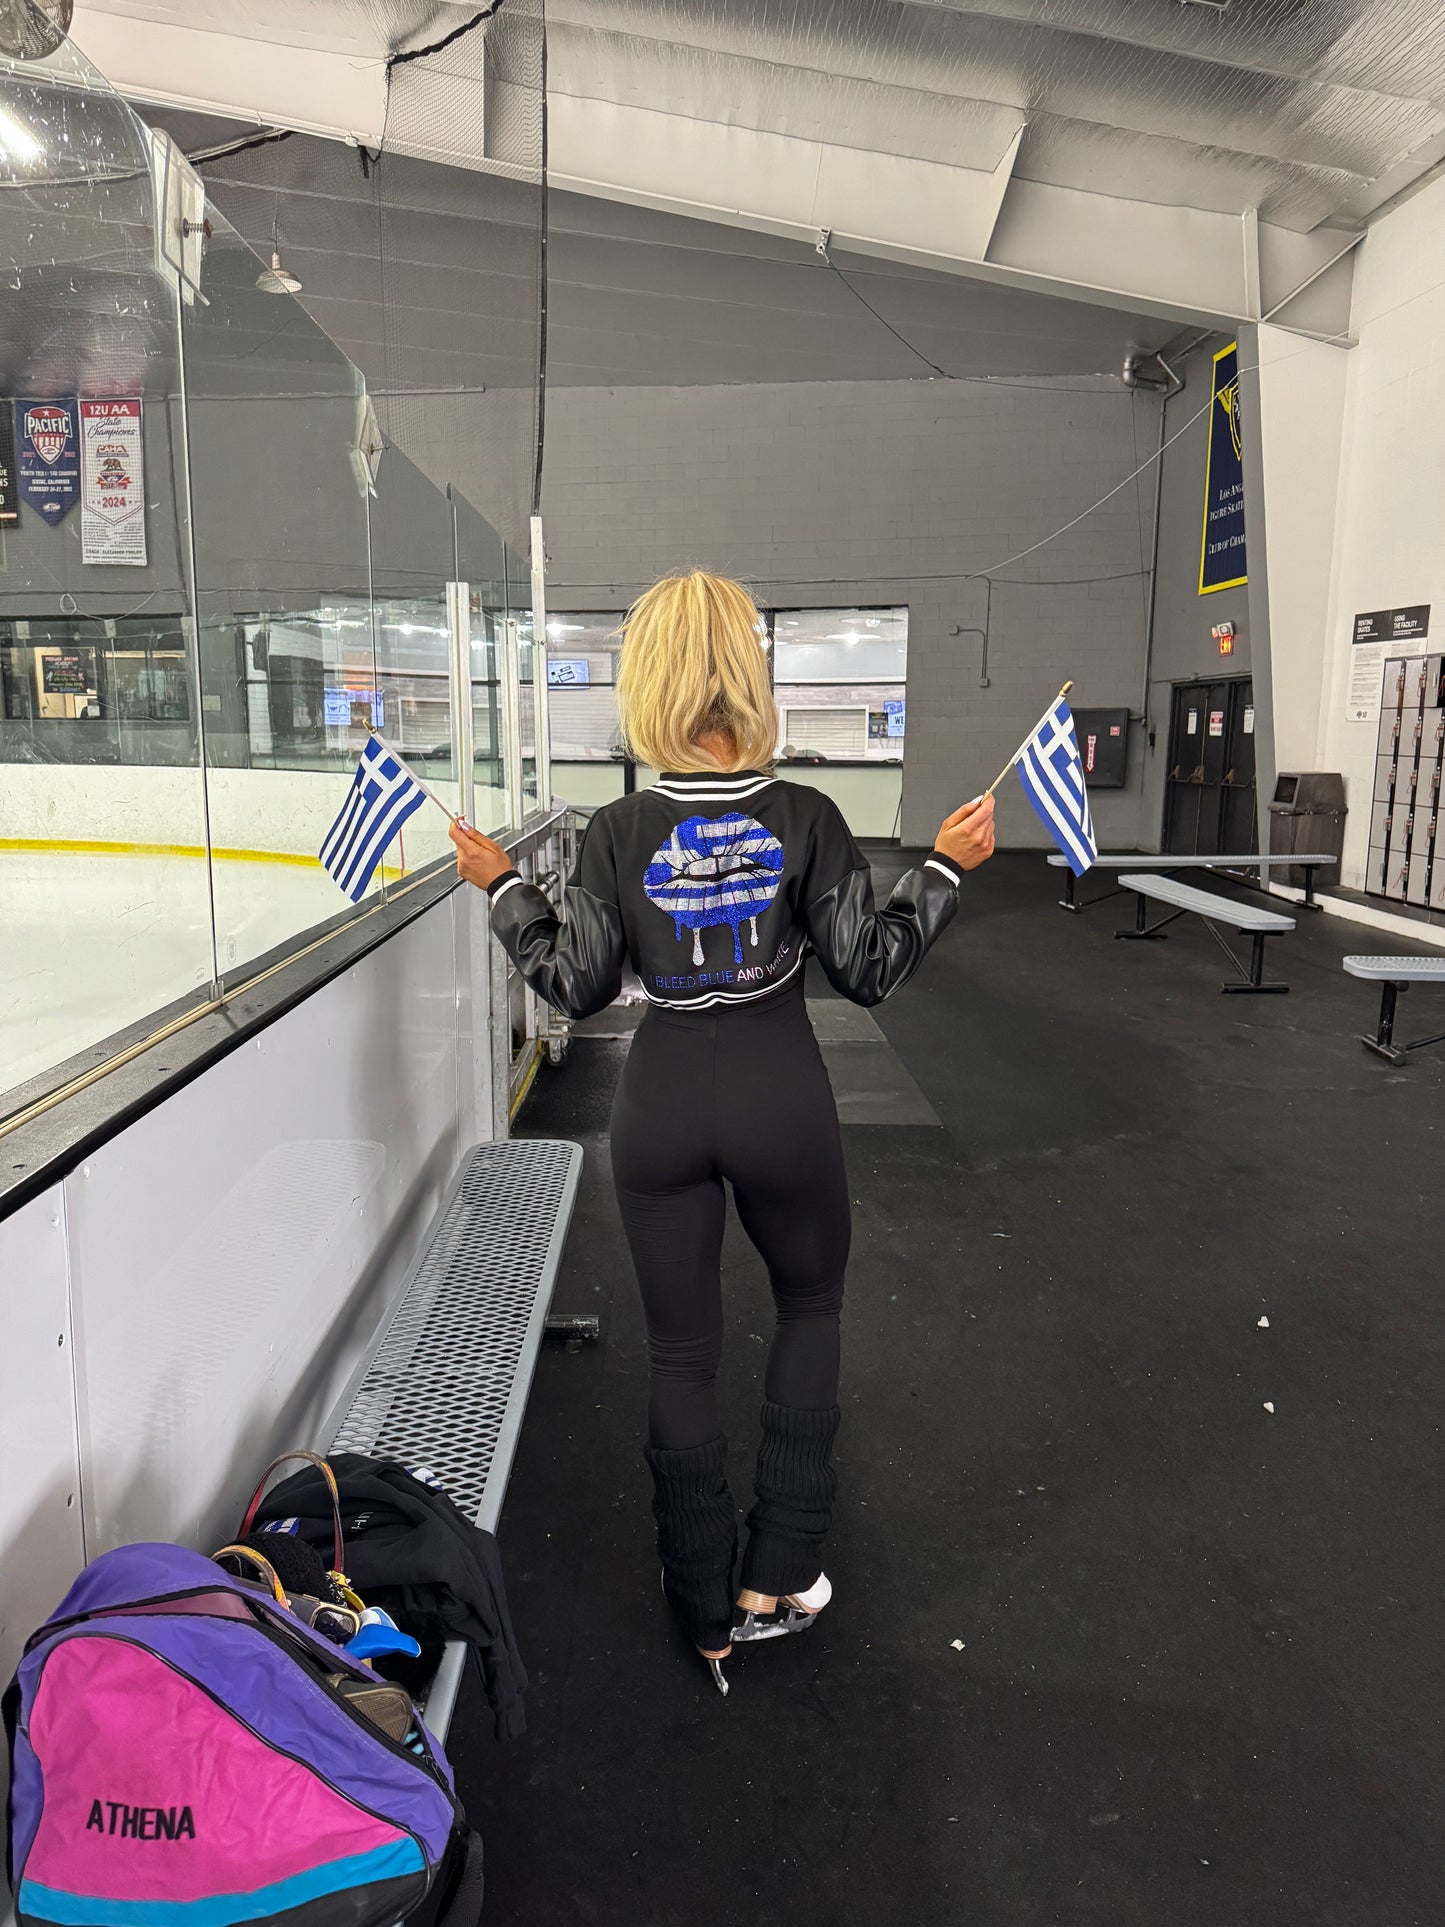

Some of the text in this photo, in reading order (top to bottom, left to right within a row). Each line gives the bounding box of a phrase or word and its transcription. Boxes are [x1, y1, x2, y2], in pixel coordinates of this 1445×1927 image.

[89, 404, 131, 416] 12U AA
[27, 416, 70, 434] PACIFIC
[96, 416, 121, 429] State
[87, 424, 136, 440] Champions
[102, 496, 127, 508] 2024
[1358, 618, 1374, 627] RENTING
[1394, 614, 1406, 622] USING
[1401, 620, 1418, 629] FACILITY
[655, 975, 696, 989] BLEED
[698, 970, 735, 986] BLUE
[737, 966, 764, 982] AND
[86, 1799, 196, 1840] ATHENA
